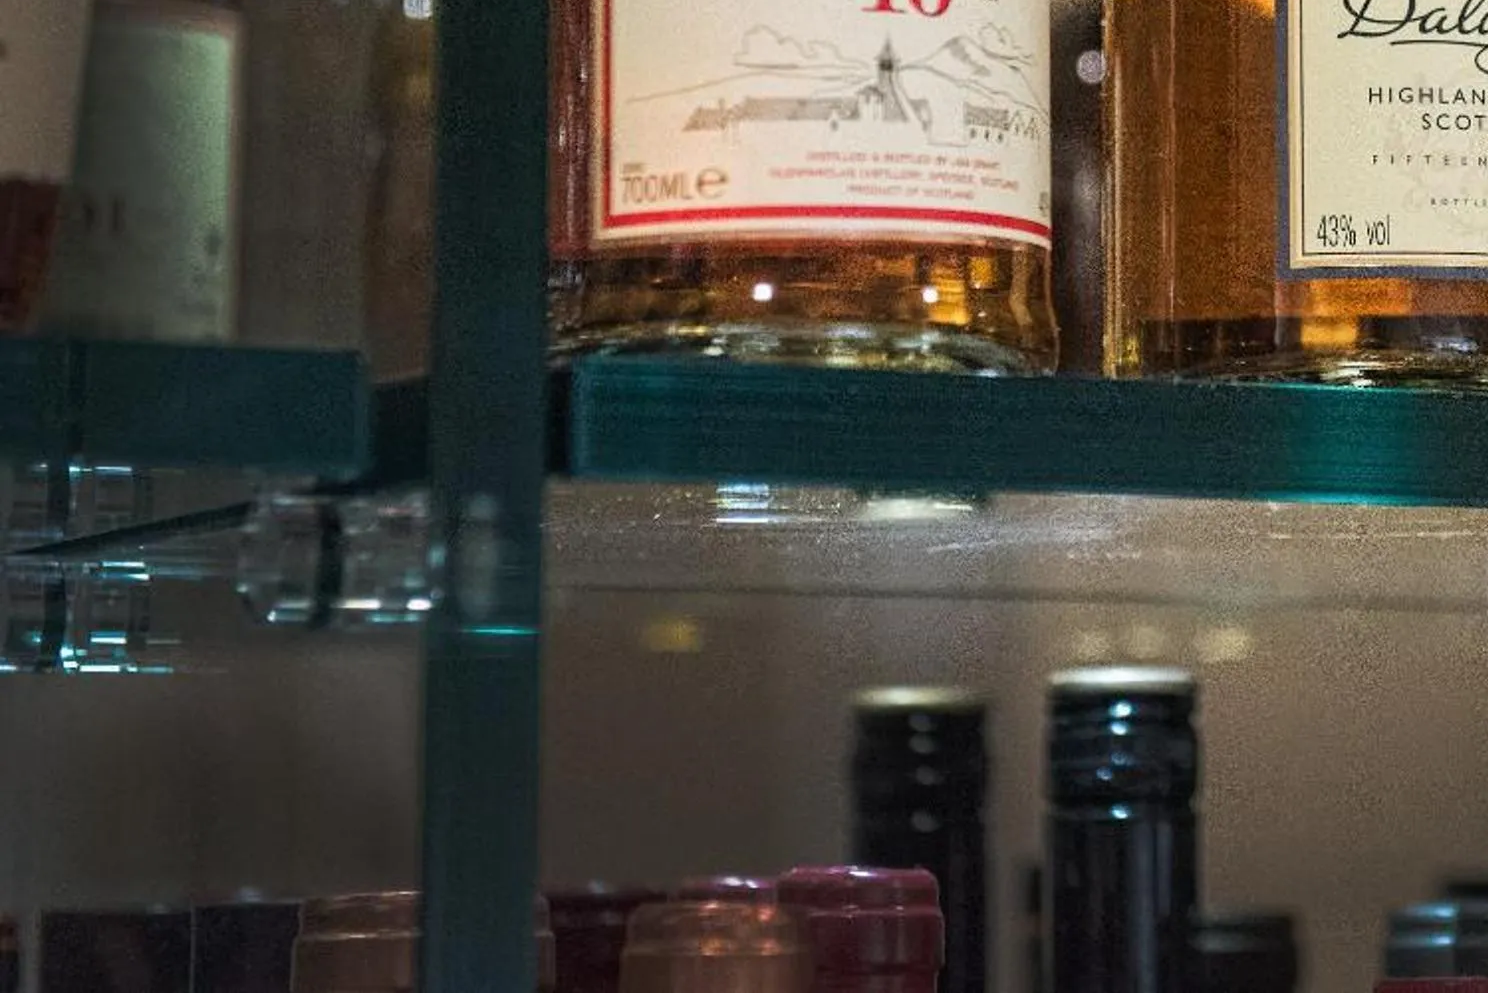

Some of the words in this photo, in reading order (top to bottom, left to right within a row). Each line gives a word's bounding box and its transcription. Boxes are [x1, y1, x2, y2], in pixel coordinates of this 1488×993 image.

[1371, 154, 1488, 168] FIFTEEN
[1316, 213, 1357, 247] 43%
[1364, 213, 1392, 247] vol
